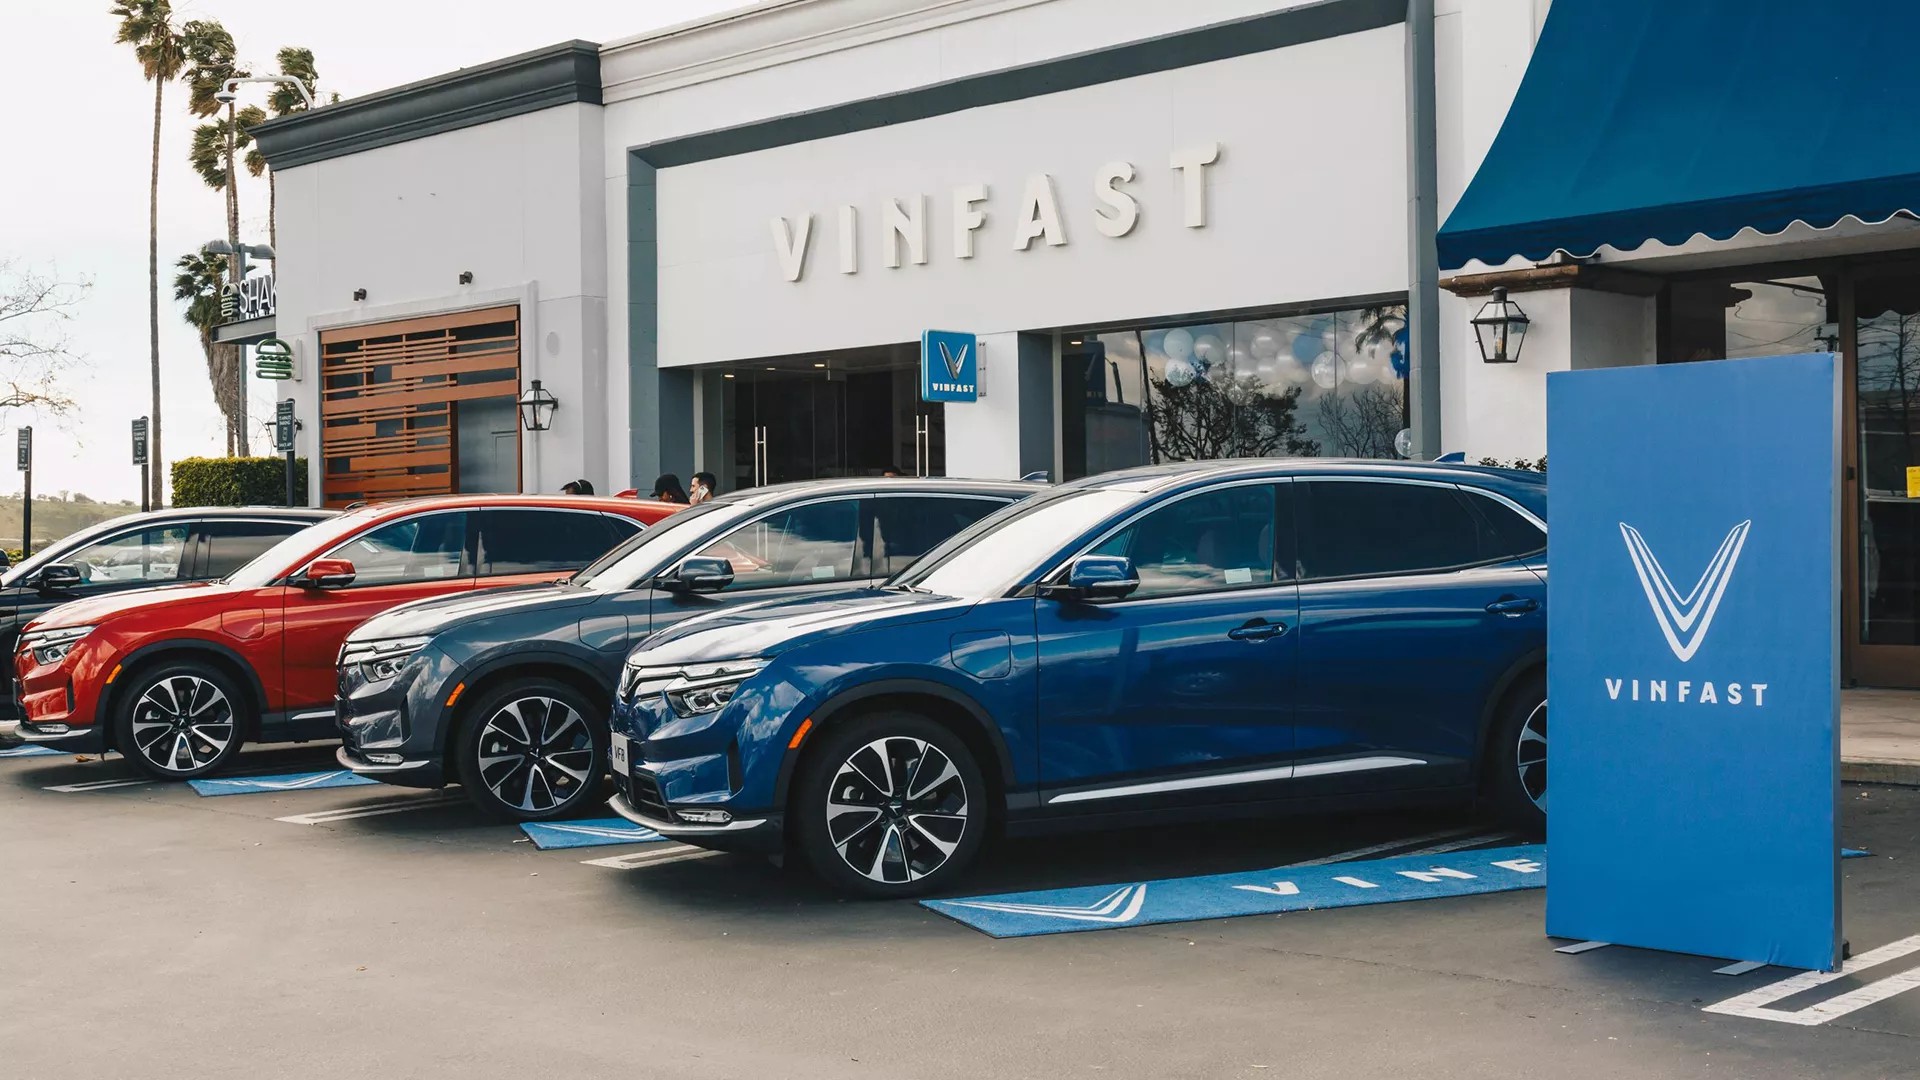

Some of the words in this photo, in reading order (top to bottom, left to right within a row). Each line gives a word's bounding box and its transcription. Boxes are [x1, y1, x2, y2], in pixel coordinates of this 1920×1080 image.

[770, 141, 1223, 283] VINFAST
[932, 383, 975, 393] VINFAST
[1605, 678, 1768, 707] VINFAST
